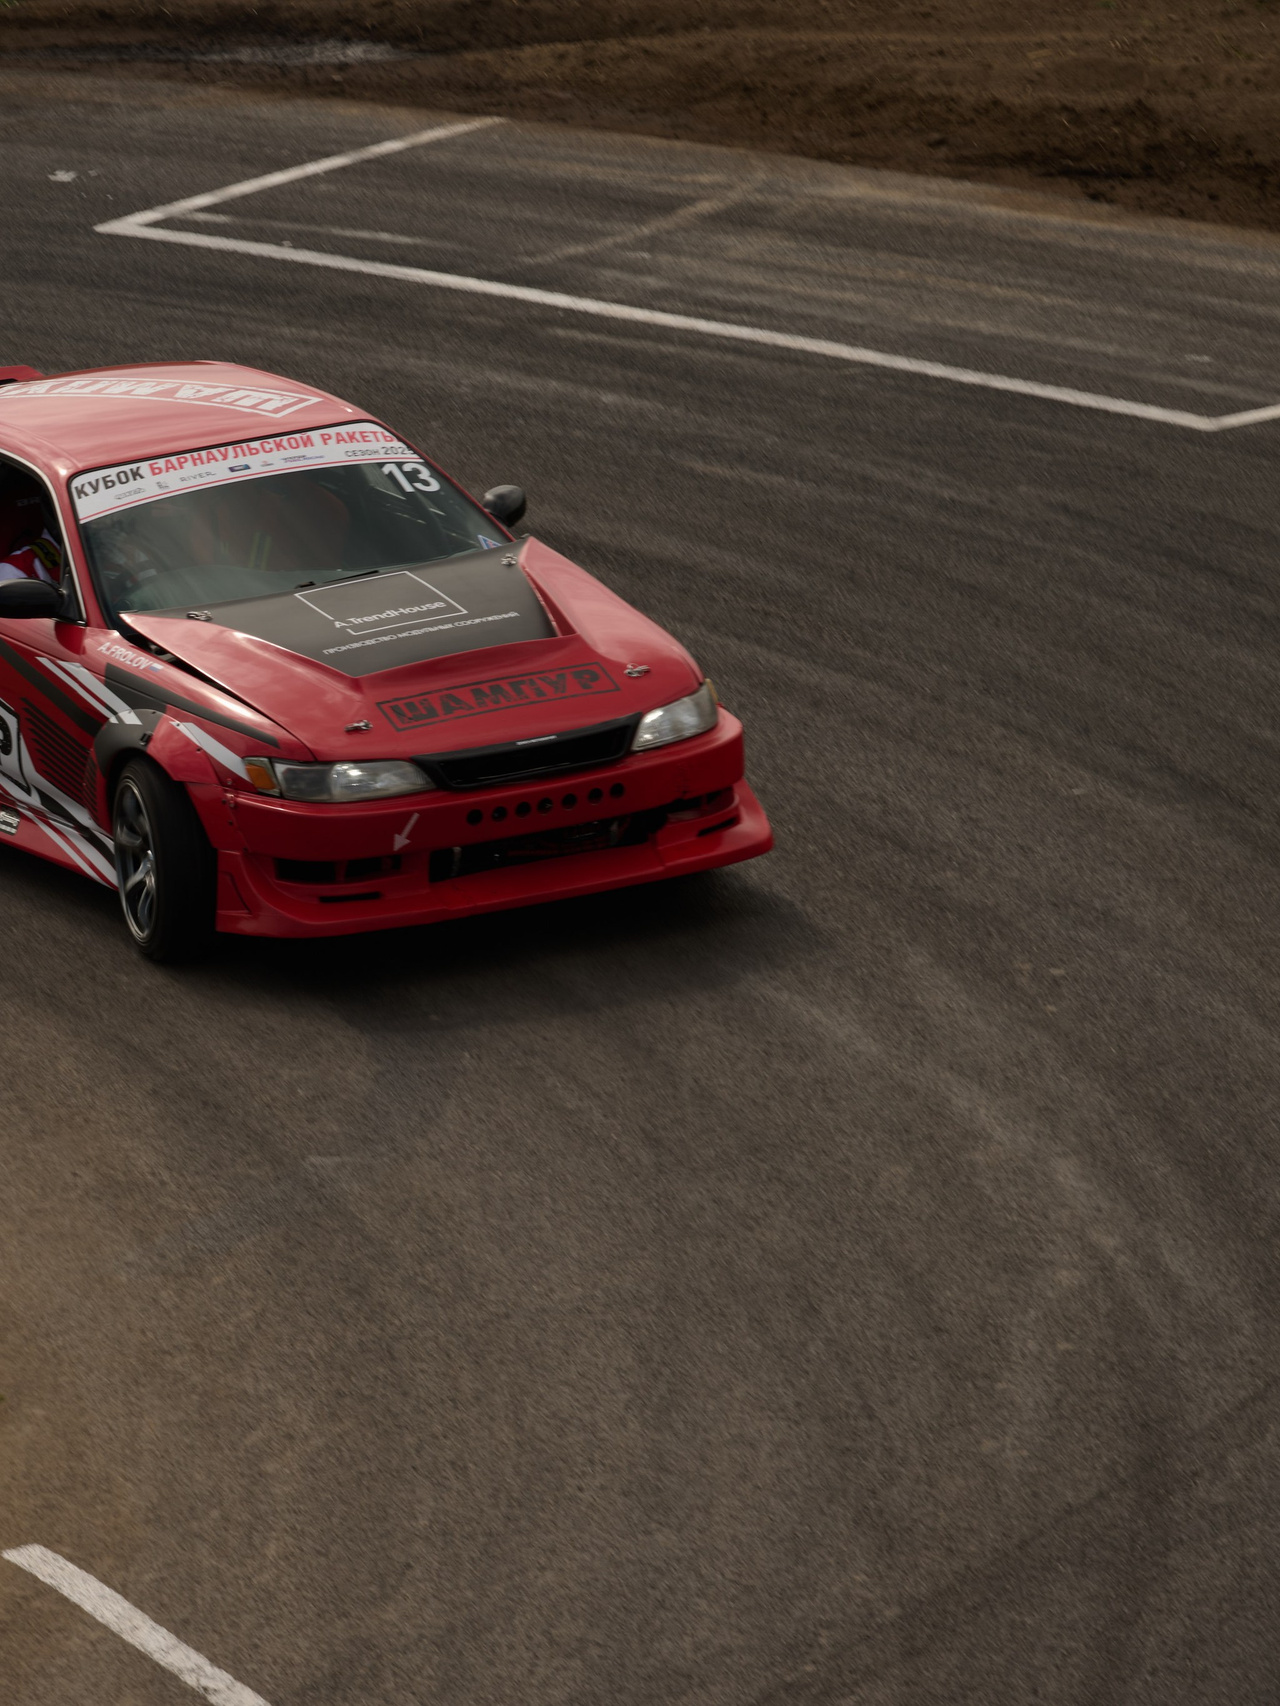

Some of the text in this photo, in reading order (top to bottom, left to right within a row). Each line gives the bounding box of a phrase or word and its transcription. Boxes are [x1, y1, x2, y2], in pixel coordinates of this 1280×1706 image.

[74, 466, 144, 499] КУБОК
[149, 433, 314, 476] БАРНАУЛЬСКОЙ
[345, 449, 380, 458] СЕЗОН
[381, 463, 440, 493] 13
[322, 634, 397, 655] ПРОИЗВОДСТВО
[390, 669, 601, 724] ШАМПУР
